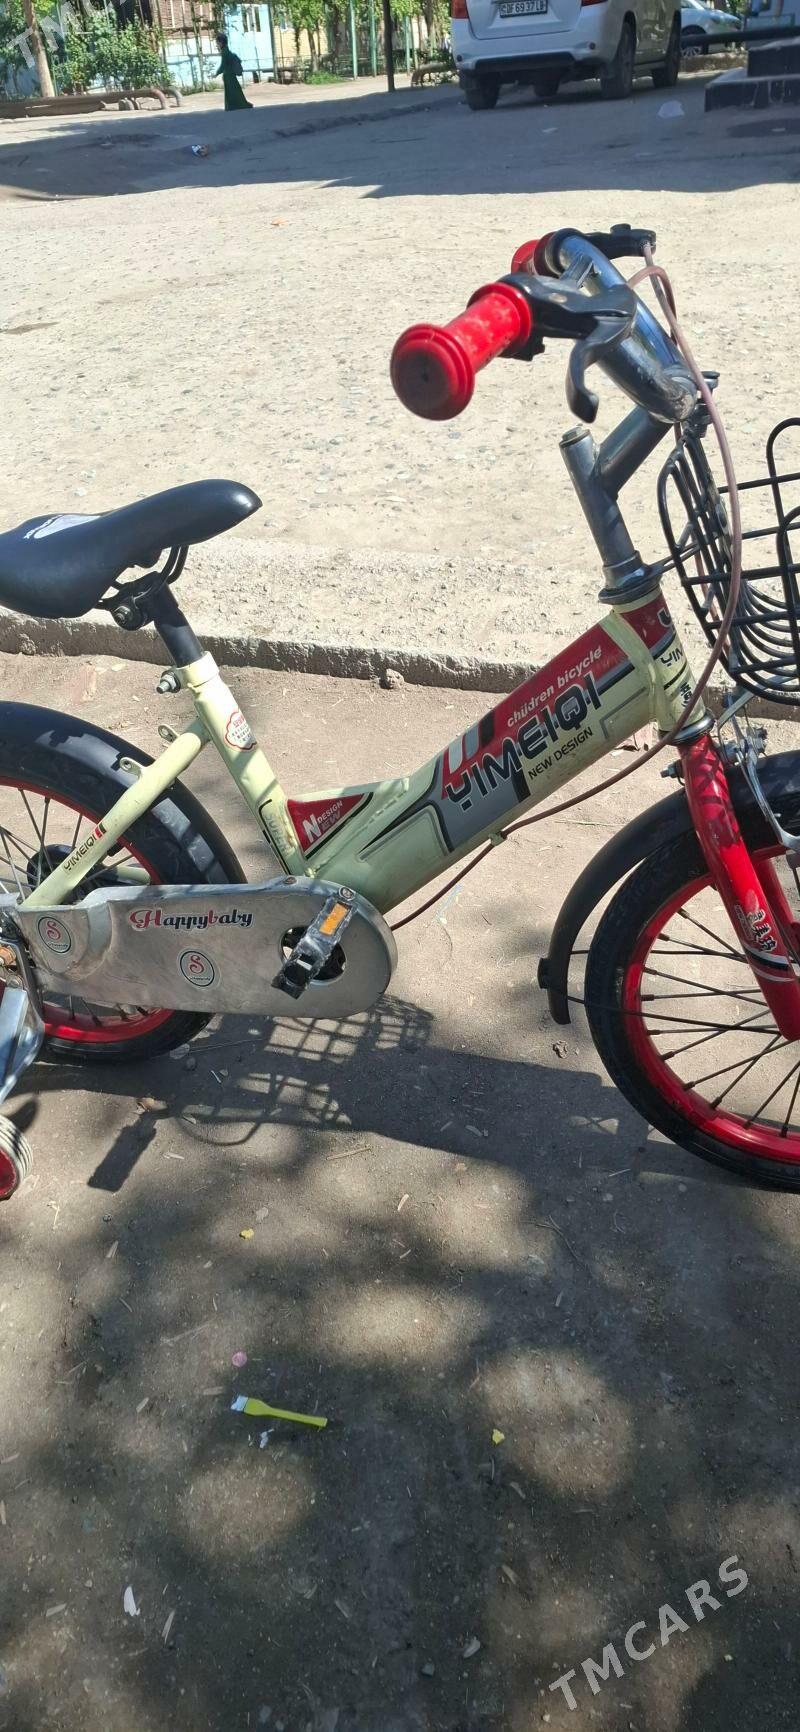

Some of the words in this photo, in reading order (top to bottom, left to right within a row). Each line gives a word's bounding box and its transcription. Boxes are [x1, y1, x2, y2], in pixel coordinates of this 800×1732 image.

[507, 685, 555, 728] children
[556, 647, 603, 689] bicycle
[446, 670, 602, 812] YIMEIQI
[528, 756, 553, 780] NEW
[553, 726, 594, 762] DESIGN
[317, 800, 343, 823] DESIGN
[63, 833, 98, 871] YIMEIQI
[129, 908, 253, 929] Happybaby
